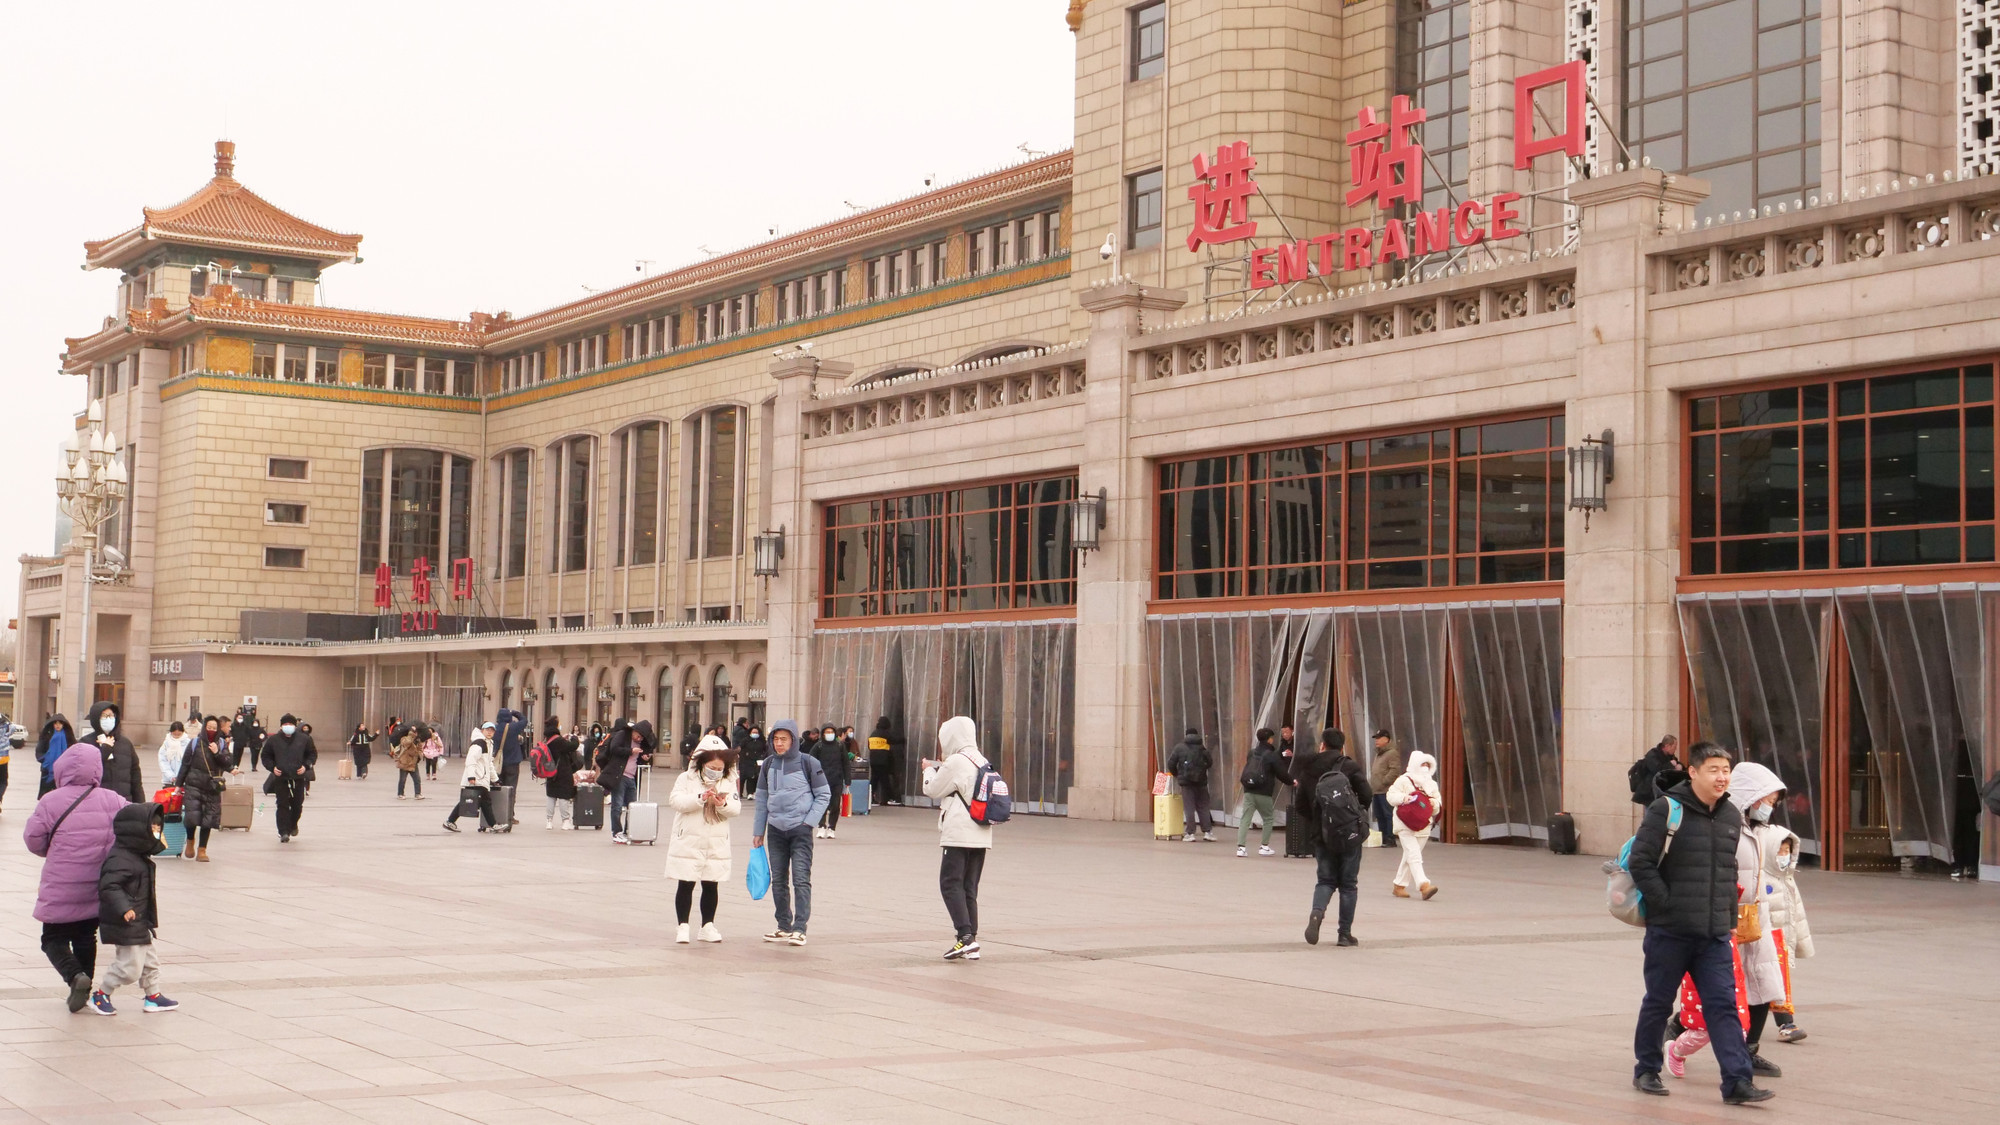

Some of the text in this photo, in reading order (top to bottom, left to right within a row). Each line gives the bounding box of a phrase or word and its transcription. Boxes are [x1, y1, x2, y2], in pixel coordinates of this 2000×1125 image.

[1186, 59, 1587, 253] 进站口
[1250, 192, 1520, 289] ENTRANCE
[374, 556, 473, 609] 出站口
[401, 609, 440, 633] EXIT
